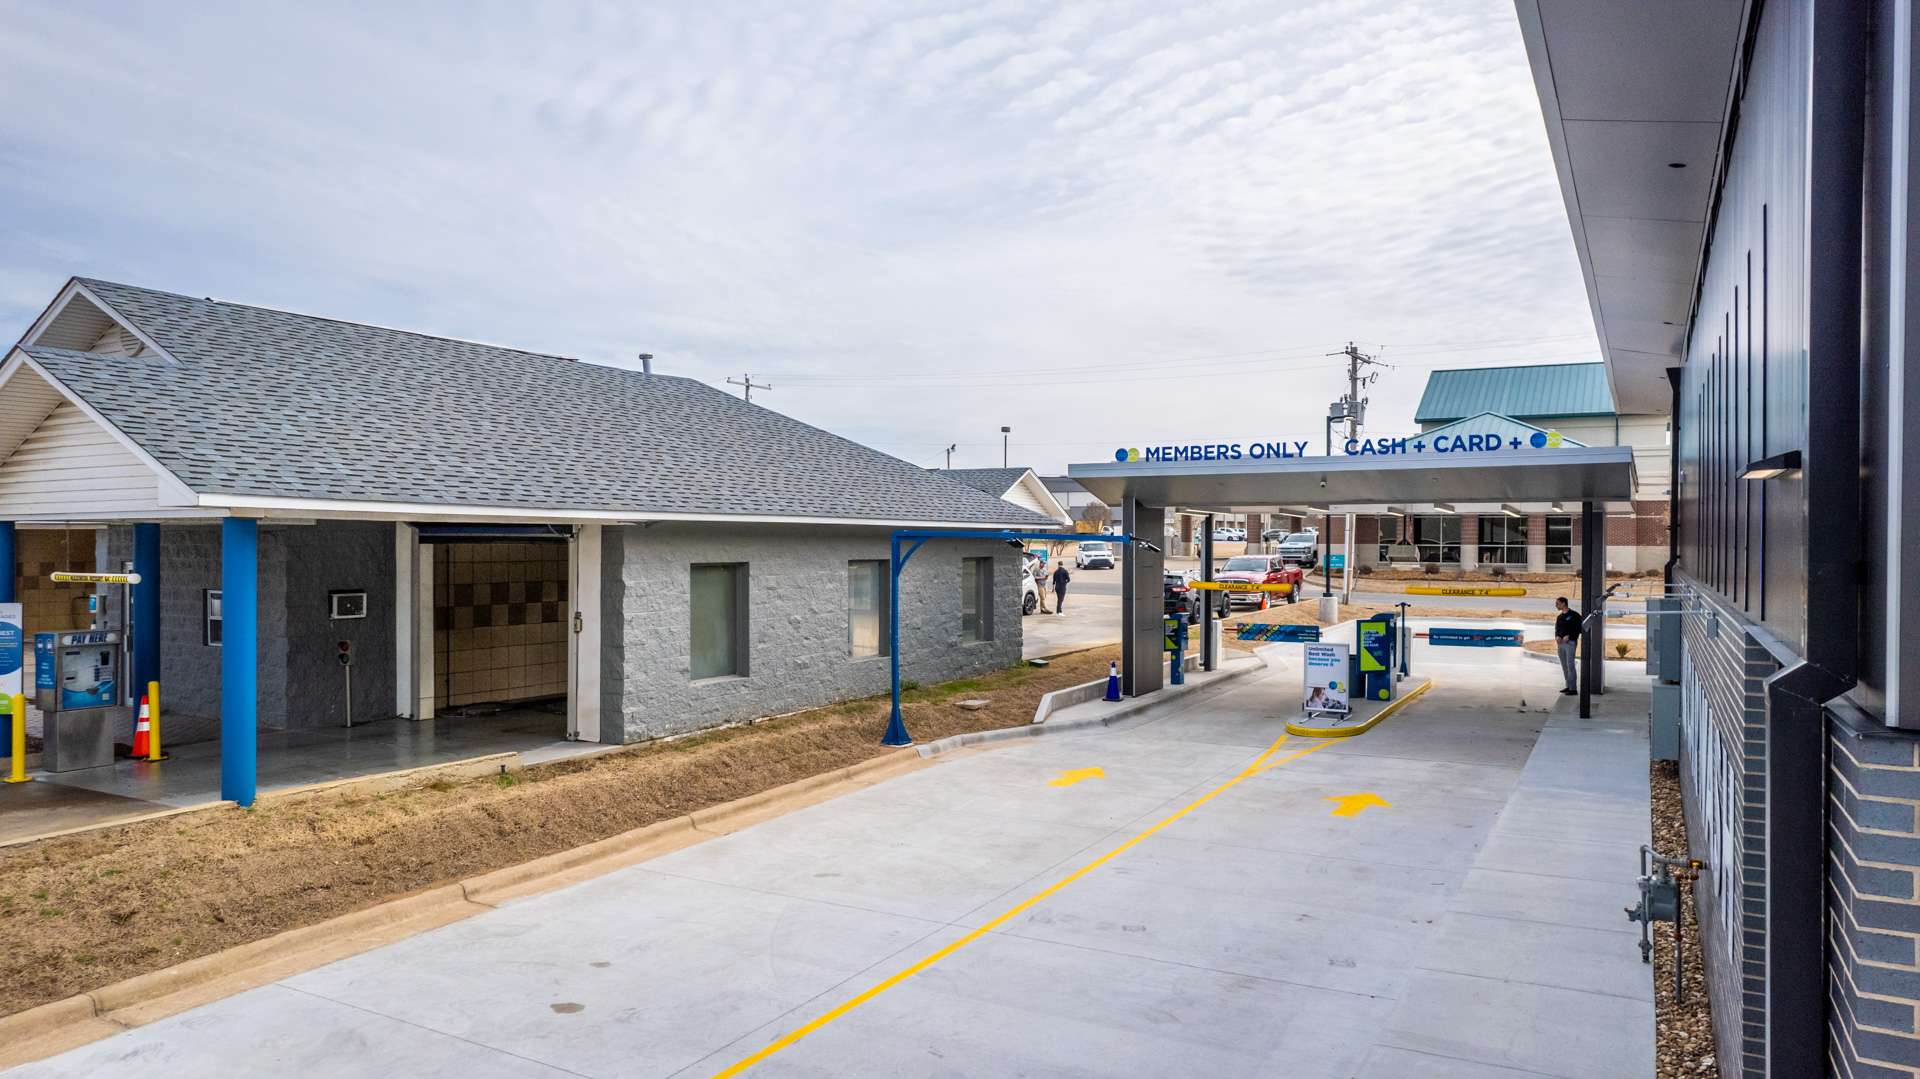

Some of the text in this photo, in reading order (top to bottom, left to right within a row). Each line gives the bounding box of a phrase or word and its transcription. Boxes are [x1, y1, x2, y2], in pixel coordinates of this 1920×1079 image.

[1145, 441, 1309, 462] MEMBERS ONLY
[1344, 438, 1407, 456] CASH
[1433, 433, 1501, 453] CARD
[71, 634, 88, 645] PAY
